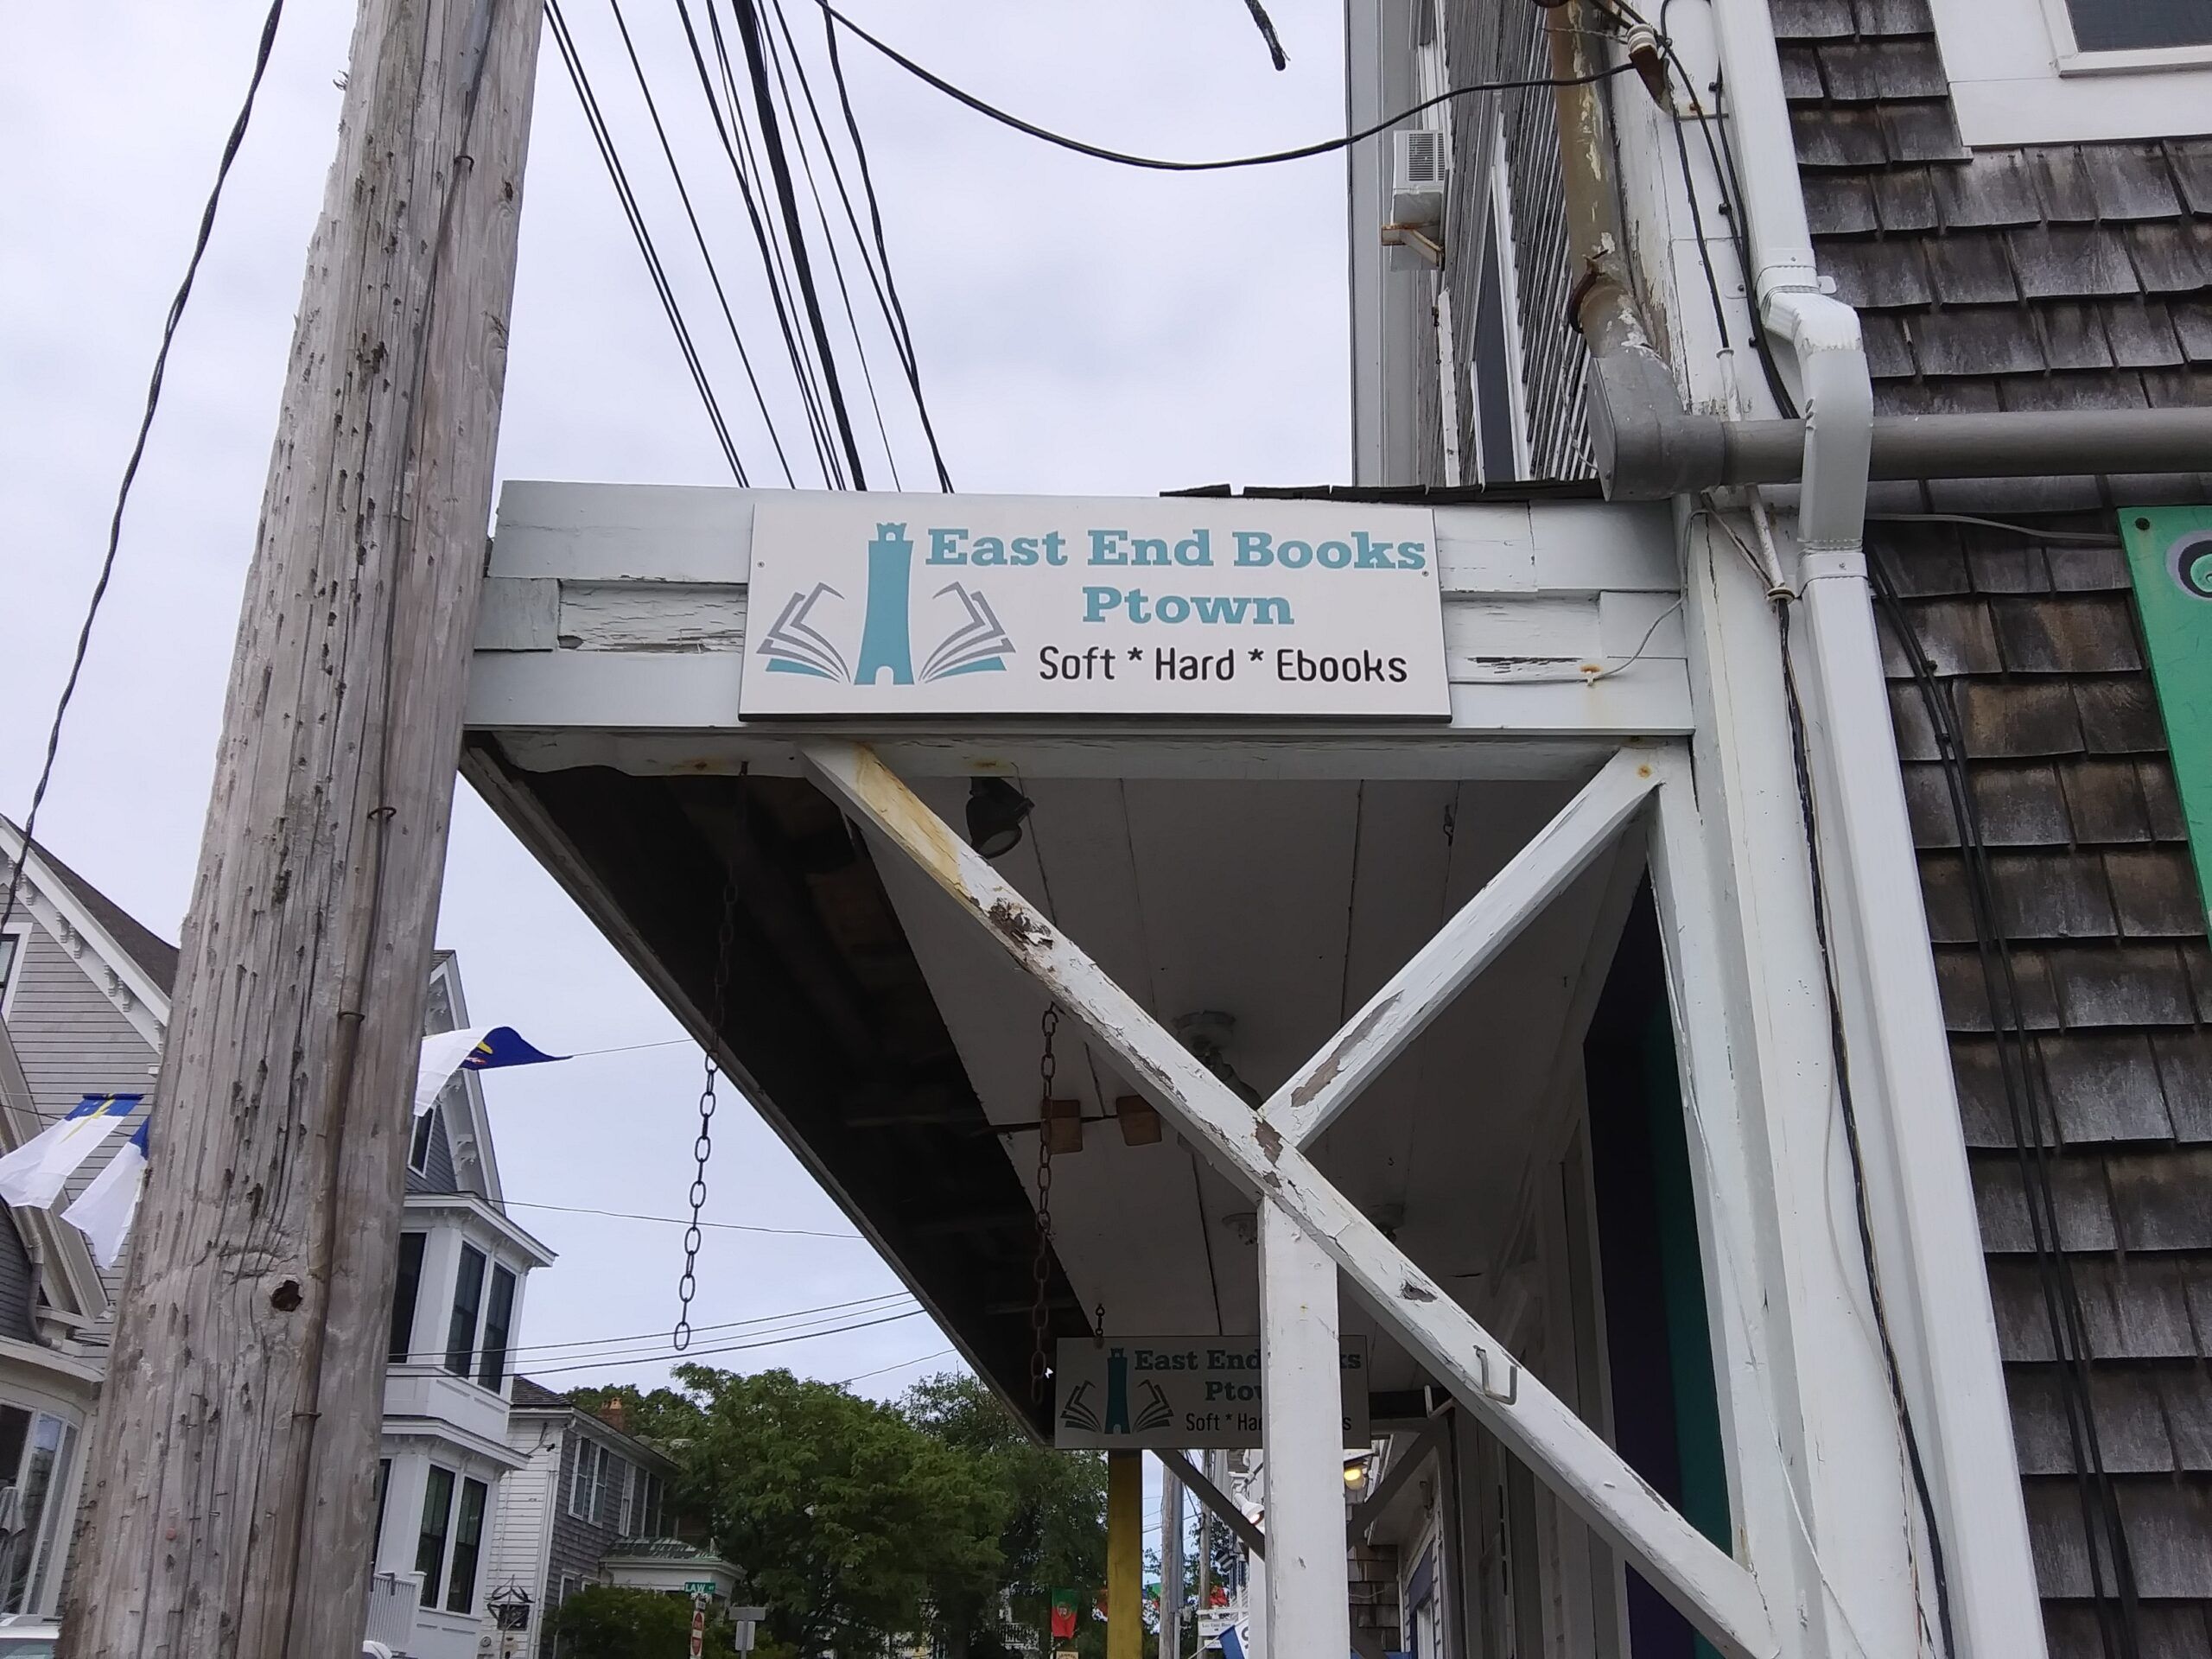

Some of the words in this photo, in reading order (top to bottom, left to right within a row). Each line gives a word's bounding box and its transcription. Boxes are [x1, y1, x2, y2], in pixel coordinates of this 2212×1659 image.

[926, 527, 1066, 567] East
[1088, 528, 1213, 567] End
[1234, 531, 1426, 570] Books
[1082, 586, 1293, 626] Ptown
[1039, 646, 1116, 680] Soft
[1156, 648, 1235, 681] Hard
[1277, 648, 1408, 683] Ebooks
[1134, 1350, 1199, 1370] East
[1206, 1349, 1262, 1370] End
[1205, 1381, 1262, 1402] Pto
[1185, 1412, 1221, 1432] Soft
[685, 1584, 706, 1592] LAW
